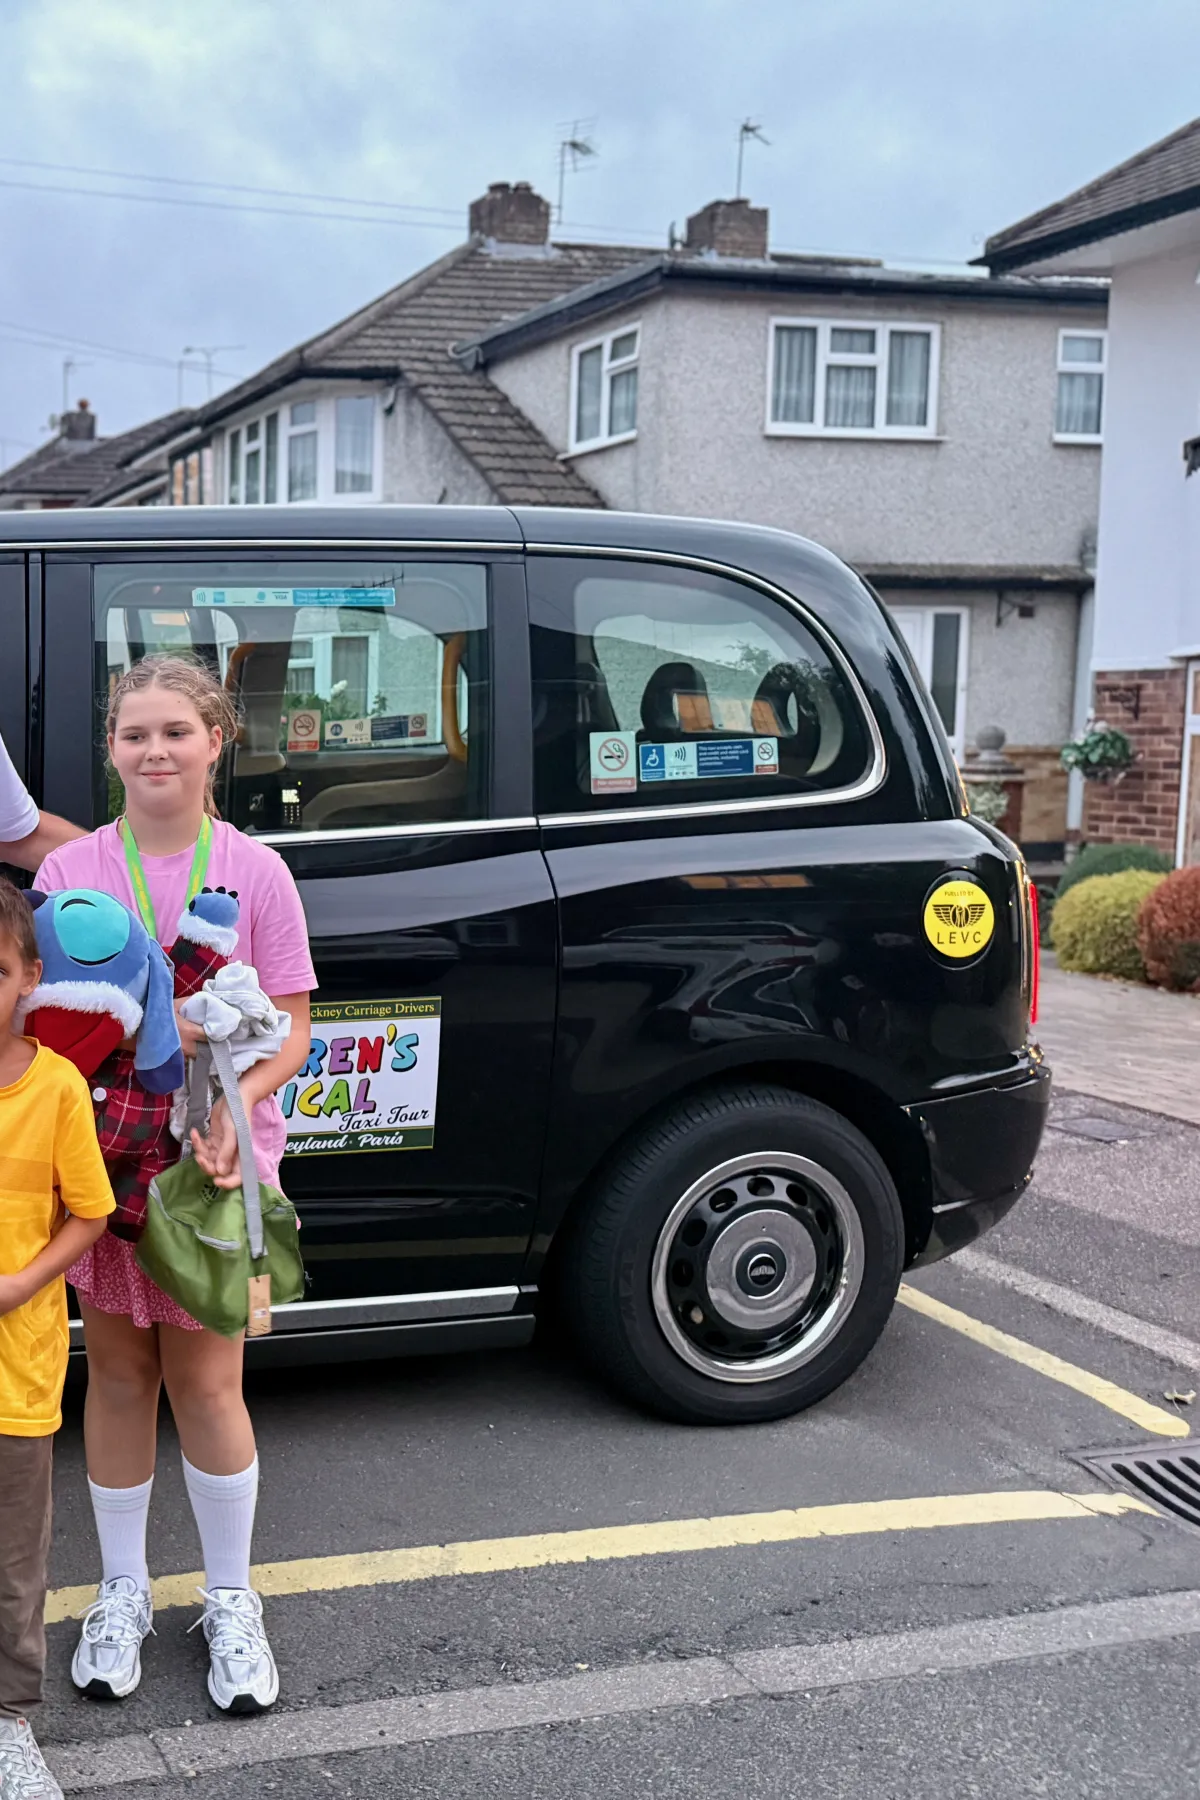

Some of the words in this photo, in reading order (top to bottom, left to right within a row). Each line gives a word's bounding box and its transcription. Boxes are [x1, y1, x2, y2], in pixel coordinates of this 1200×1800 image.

[937, 931, 982, 945] LEVC
[310, 1006, 342, 1019] ckney
[344, 1005, 392, 1017] Carriage
[394, 1003, 435, 1014] Drivers
[298, 1023, 420, 1078] REN'S
[281, 1078, 377, 1119] ICAL
[338, 1111, 382, 1132] Taxi
[387, 1104, 430, 1125] Tour
[286, 1134, 348, 1154] eyland
[357, 1131, 404, 1148] Paris
